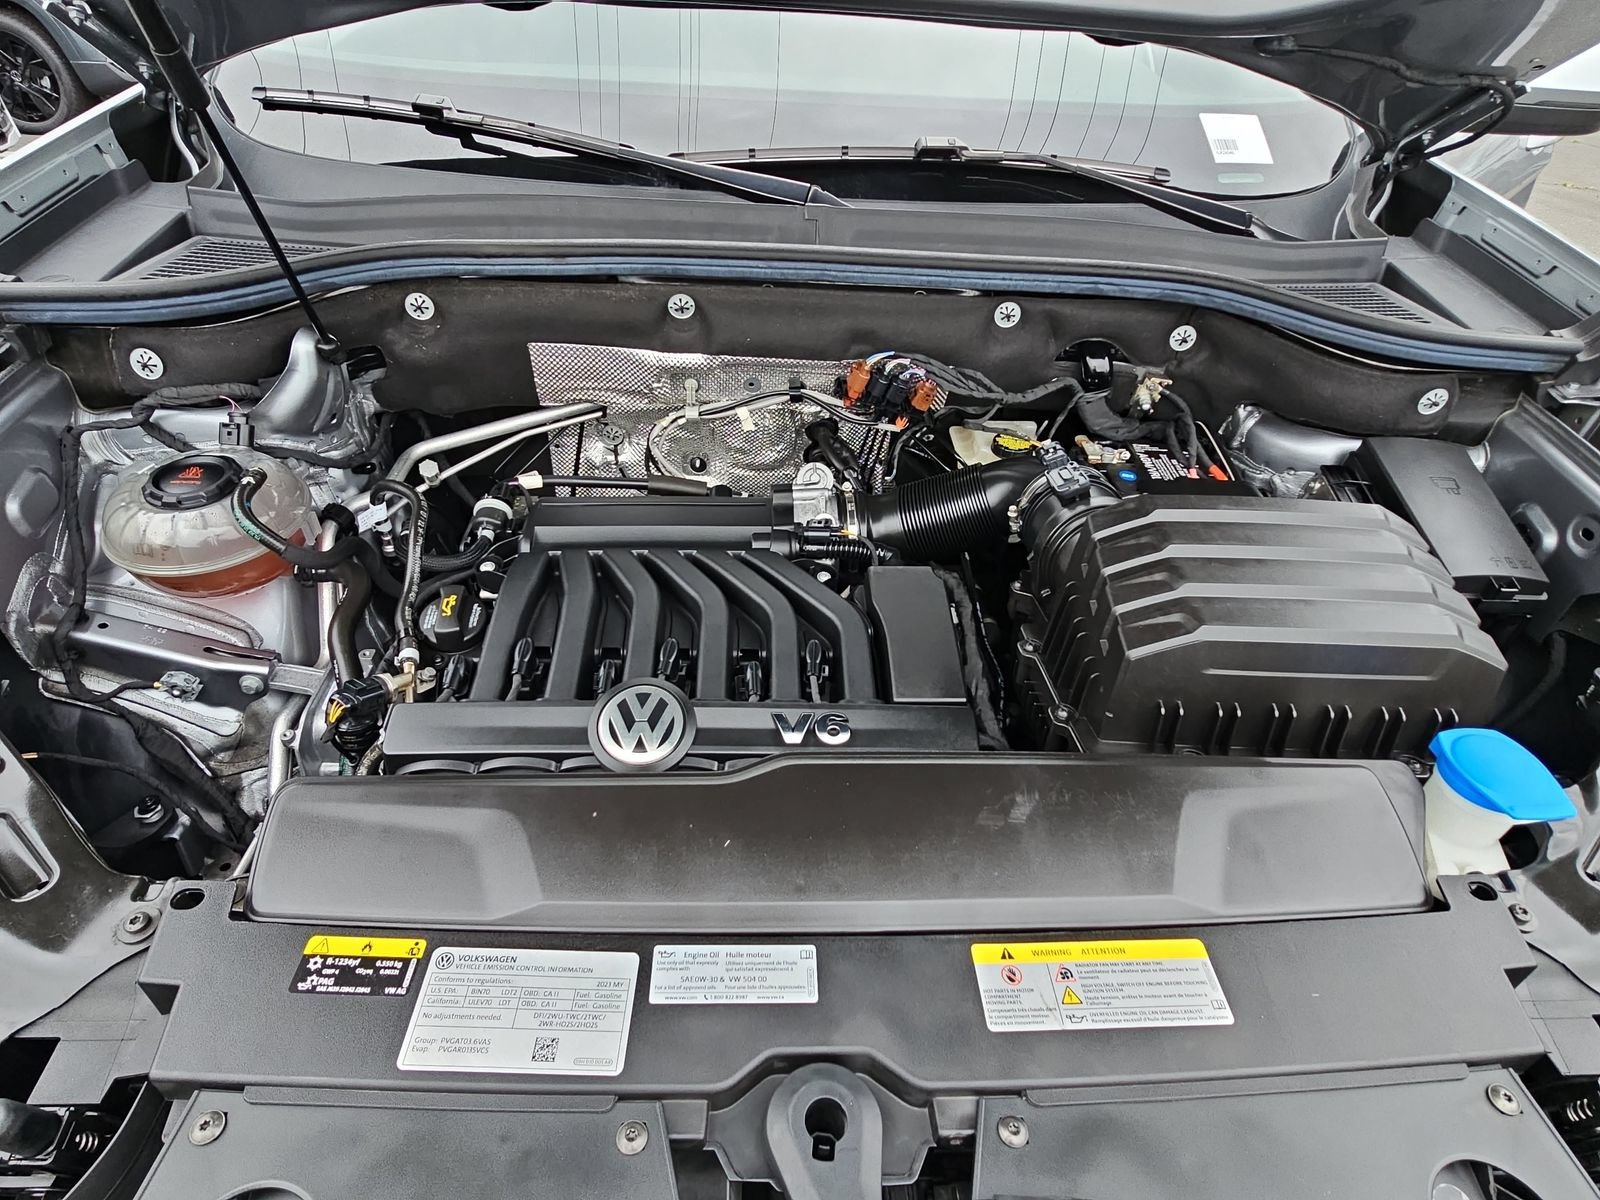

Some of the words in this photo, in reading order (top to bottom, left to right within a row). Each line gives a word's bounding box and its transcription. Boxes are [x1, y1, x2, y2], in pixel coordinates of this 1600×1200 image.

[770, 711, 851, 746] V6
[458, 954, 518, 964] VOLKSWAGEN
[684, 952, 708, 960] Engine
[394, 960, 403, 968] kg
[318, 978, 336, 986] PAG
